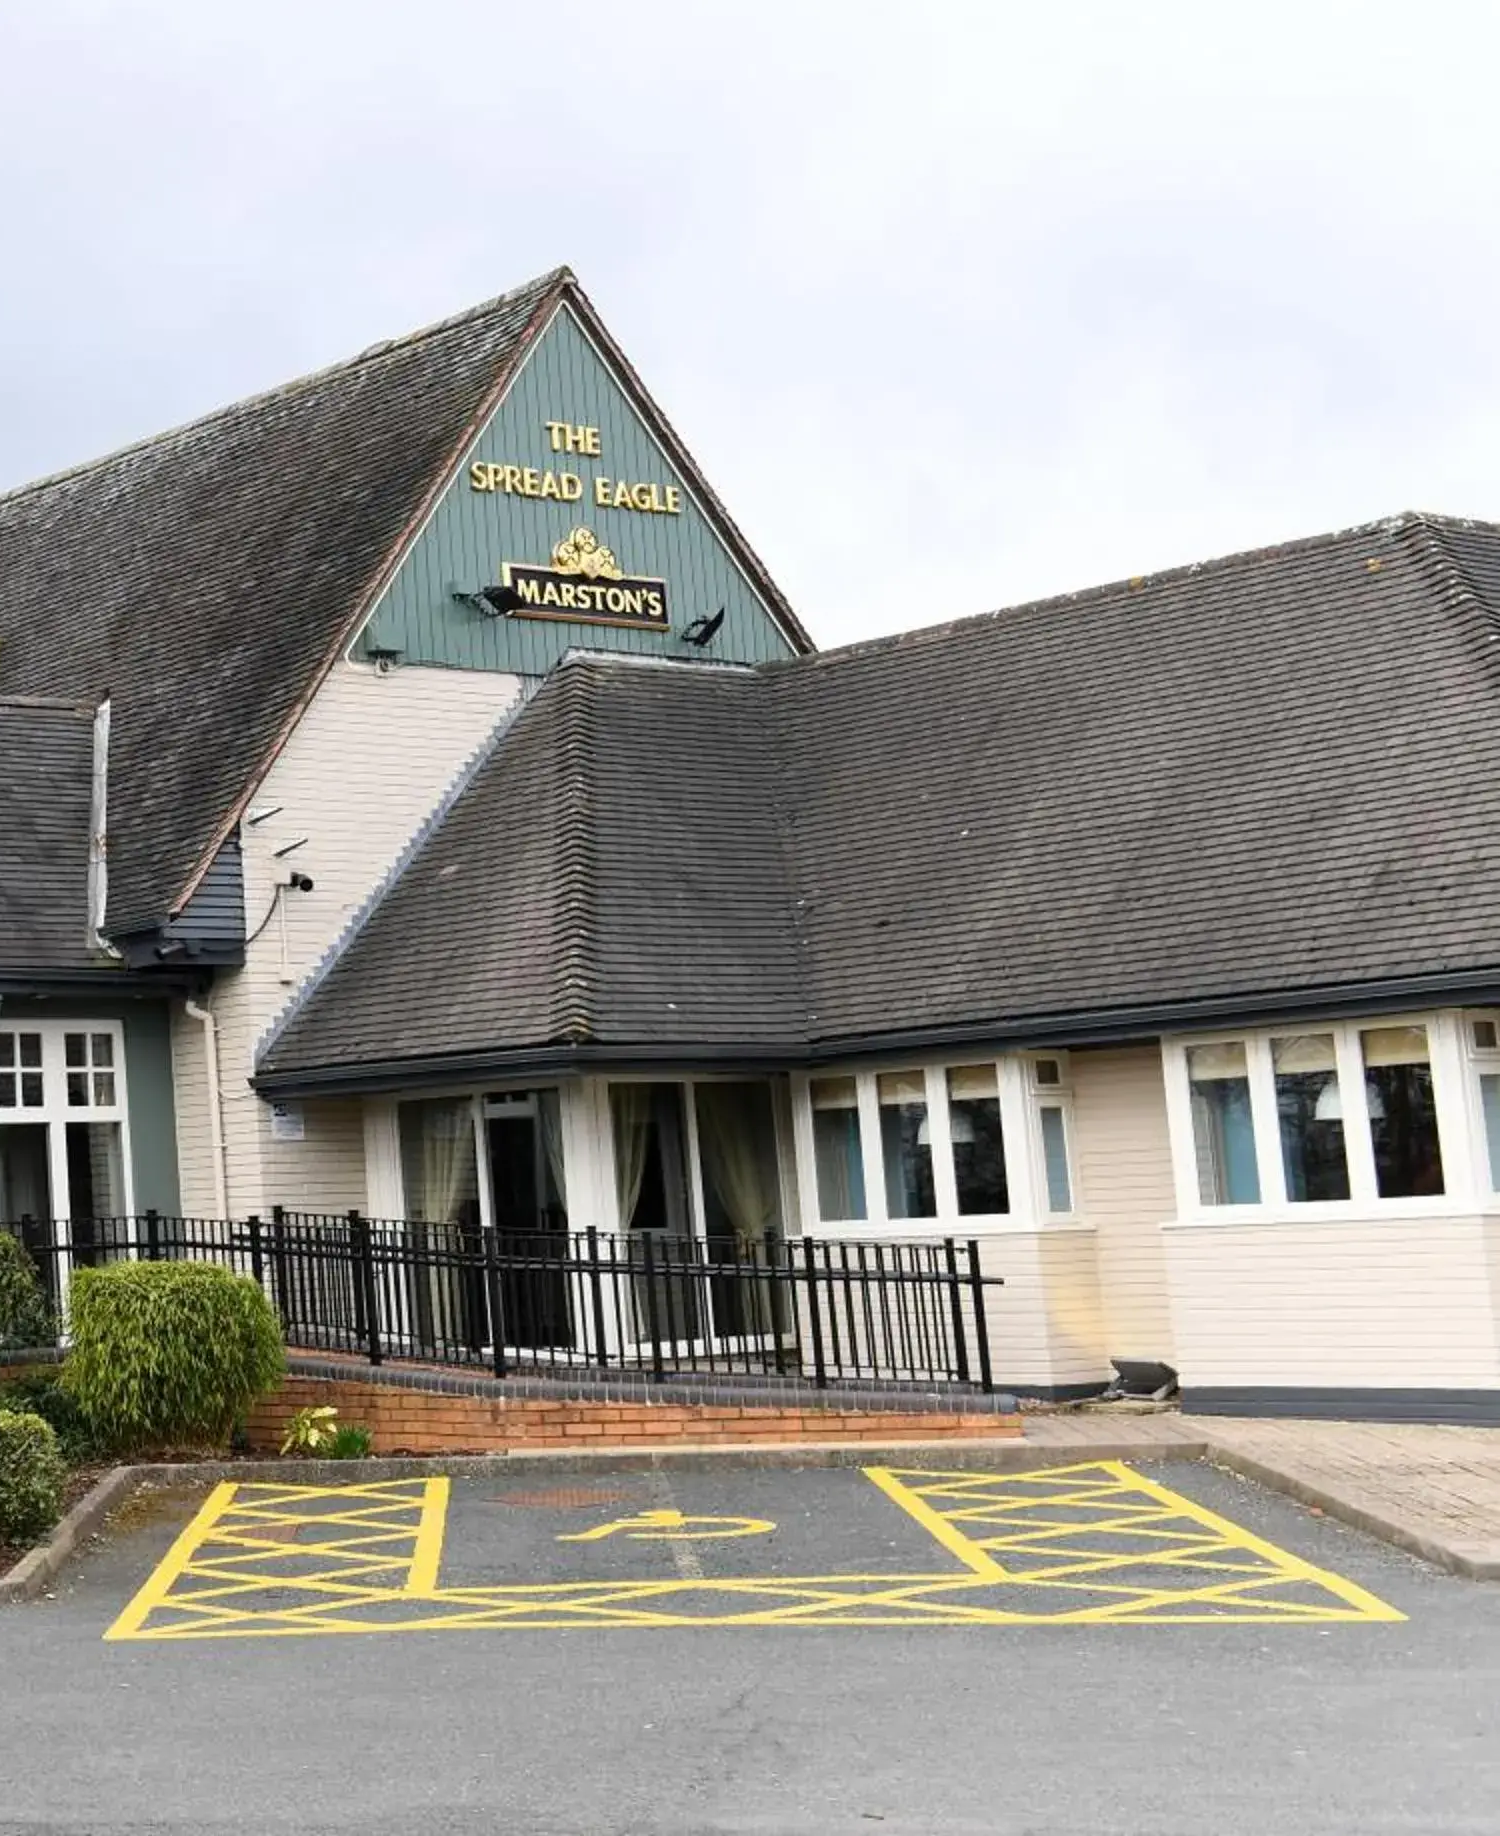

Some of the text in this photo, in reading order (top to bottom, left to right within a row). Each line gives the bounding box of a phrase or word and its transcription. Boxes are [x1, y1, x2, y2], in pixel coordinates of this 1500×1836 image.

[546, 421, 601, 455] THE
[470, 462, 681, 514] SPREAD EAGLE
[517, 580, 662, 615] MARSTON'S
